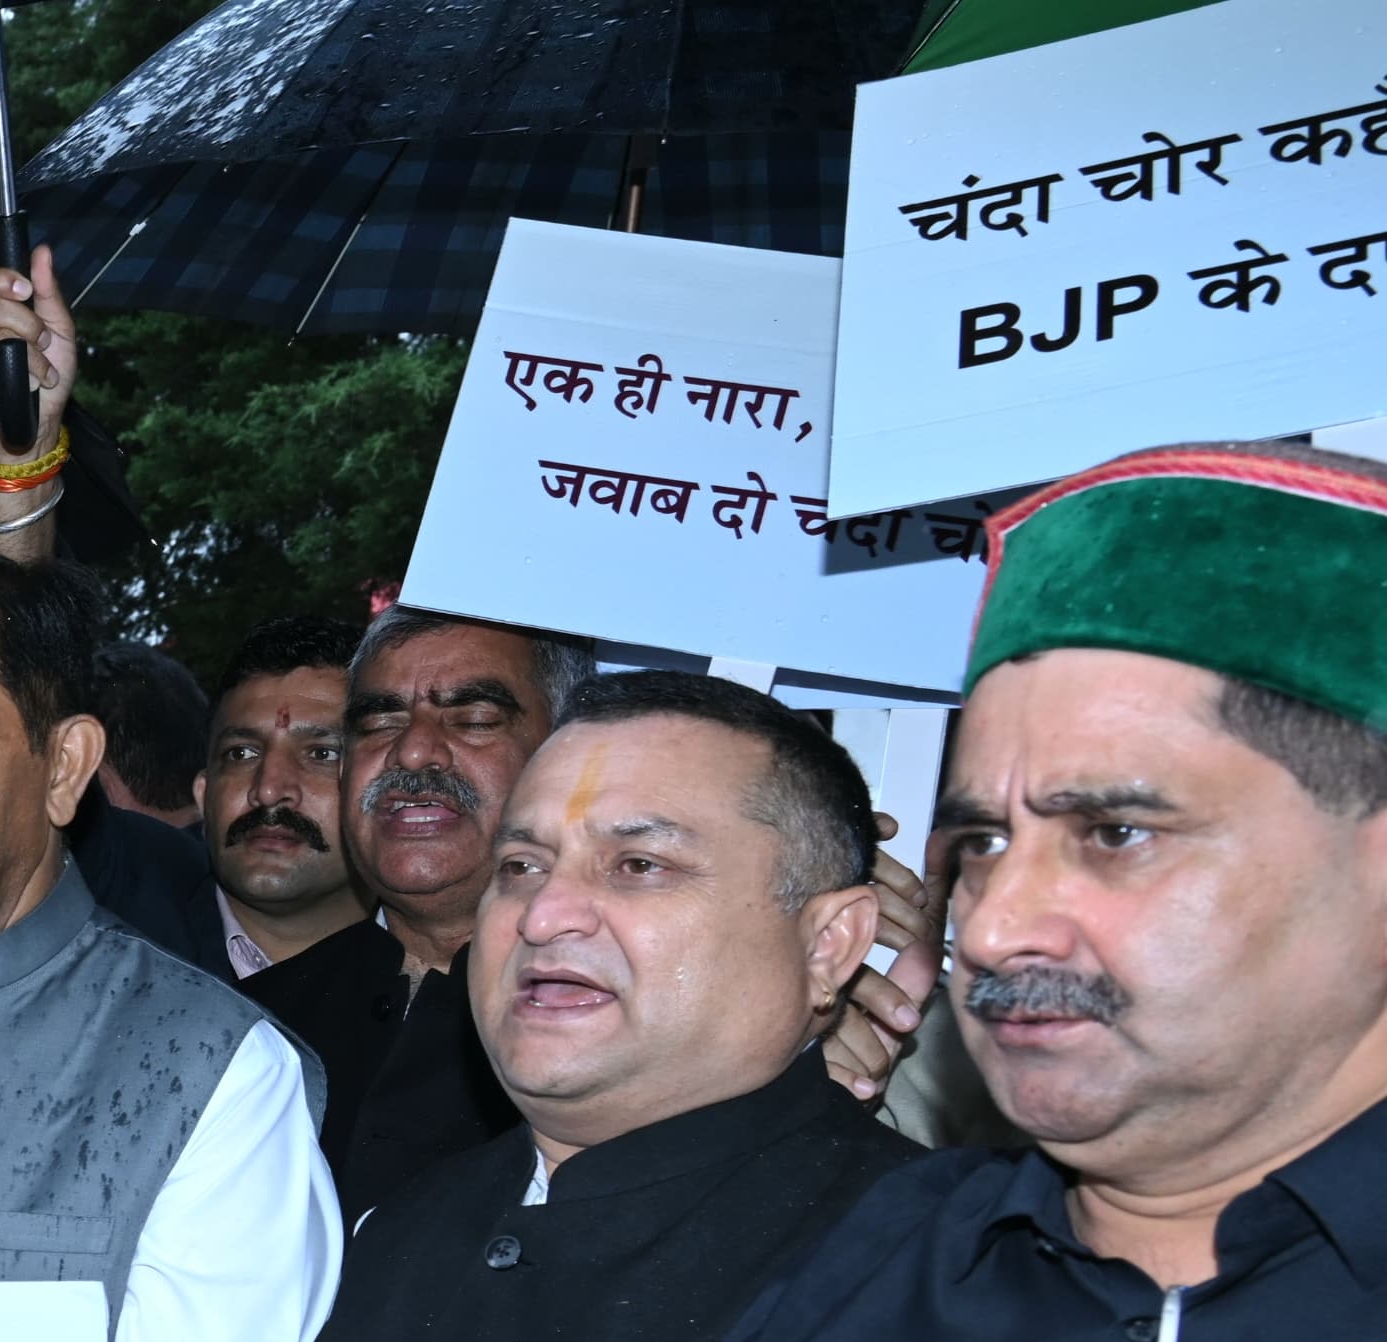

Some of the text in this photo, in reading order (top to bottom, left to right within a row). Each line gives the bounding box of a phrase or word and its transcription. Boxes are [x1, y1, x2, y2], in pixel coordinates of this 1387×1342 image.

[899, 174, 1064, 240] चंदा
[1079, 132, 1243, 201] चोर
[959, 275, 1158, 369] BJP
[1187, 240, 1289, 312] के
[503, 351, 812, 442] एक ही नारा,
[538, 460, 700, 523] जवाब
[711, 472, 778, 539] दो
